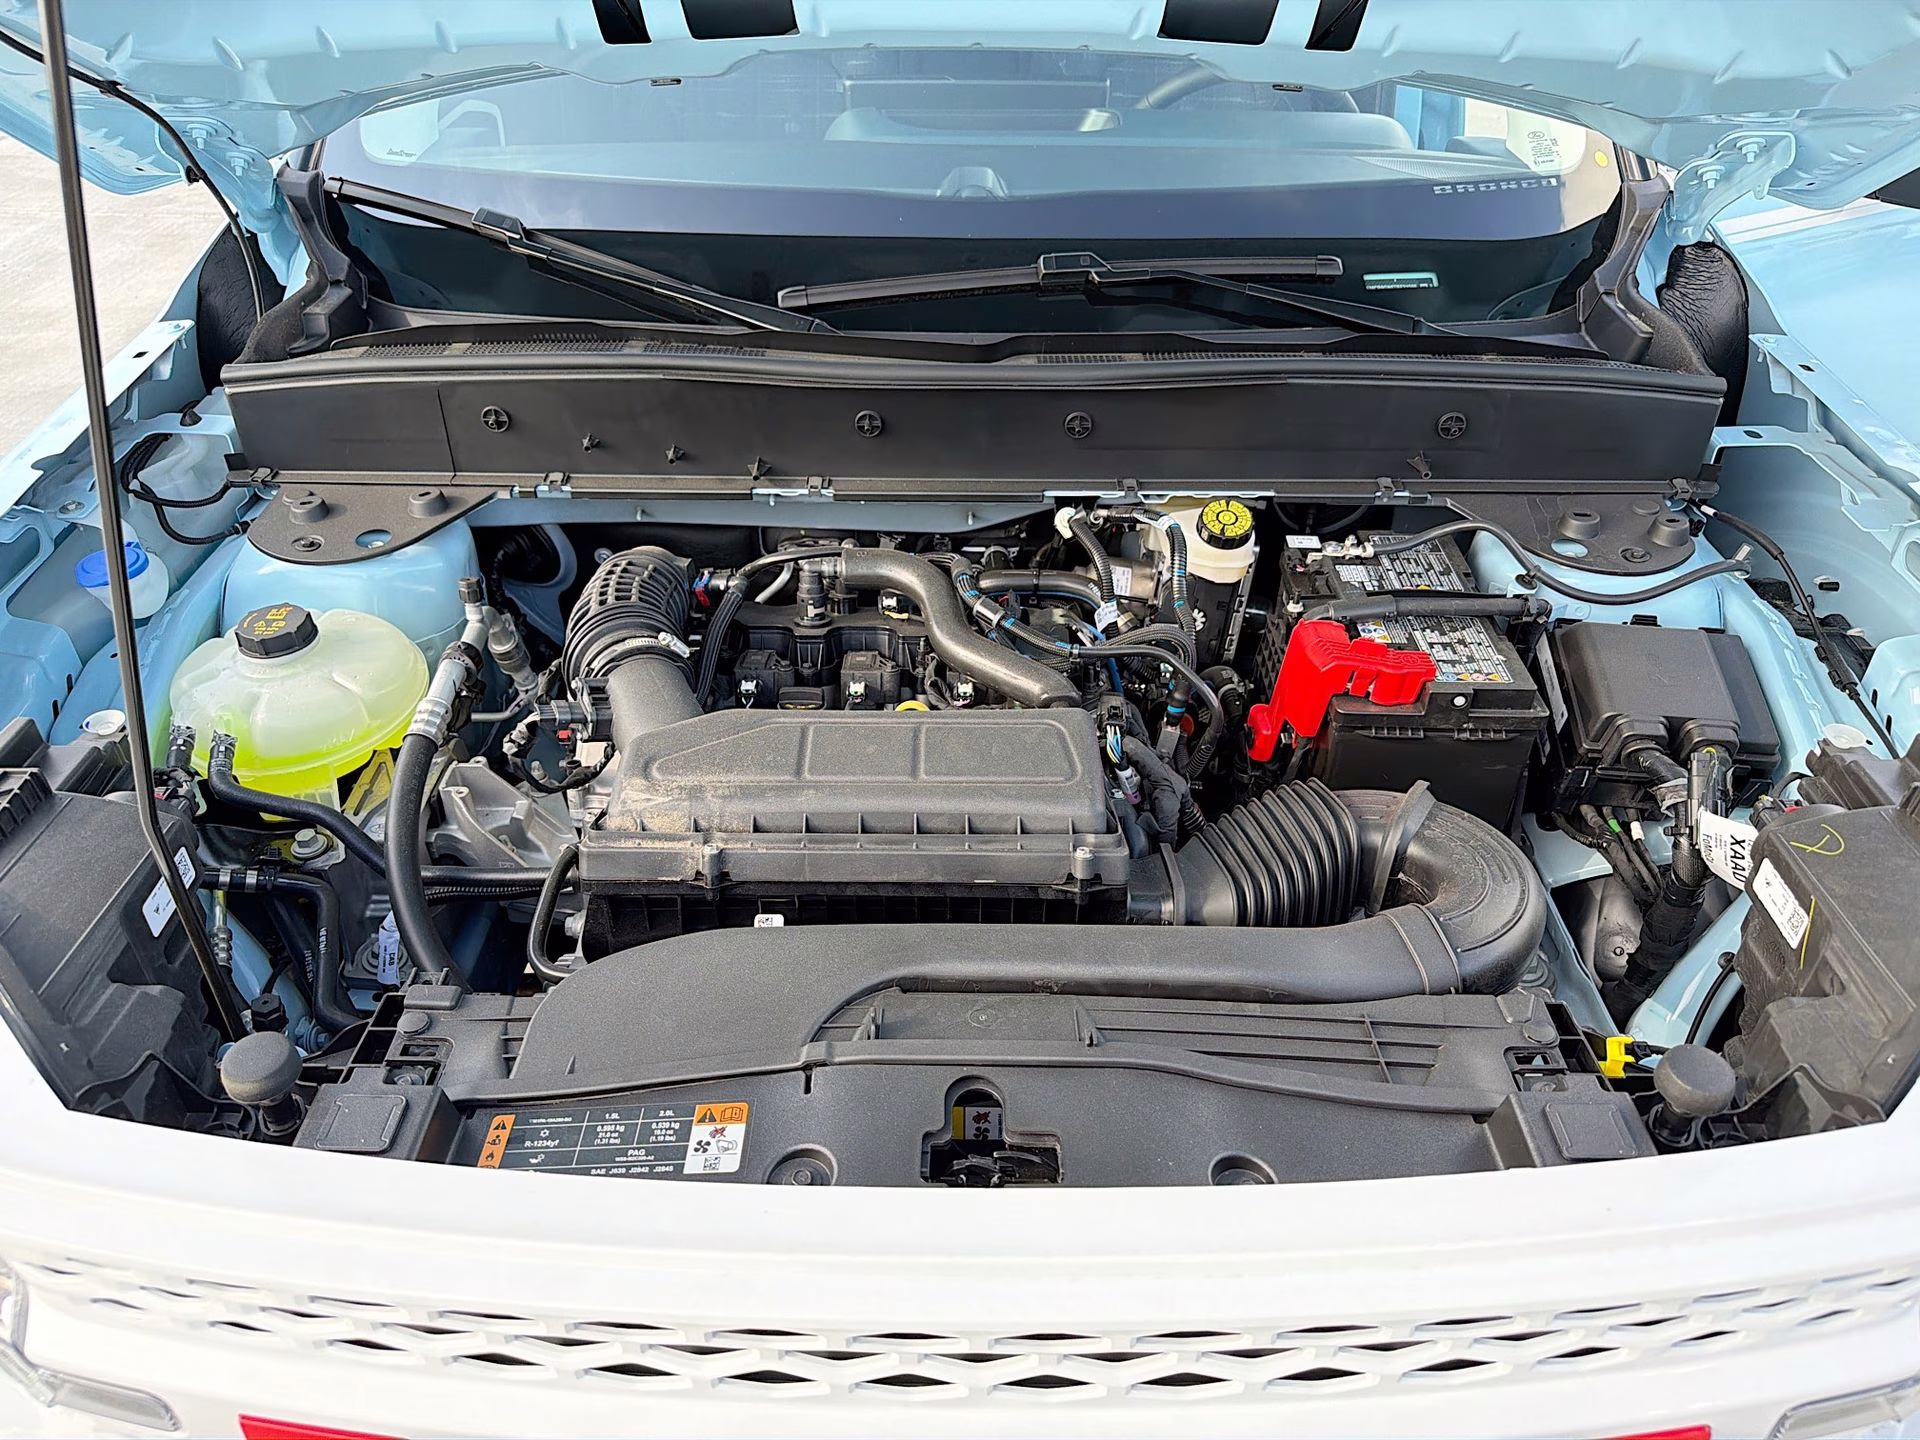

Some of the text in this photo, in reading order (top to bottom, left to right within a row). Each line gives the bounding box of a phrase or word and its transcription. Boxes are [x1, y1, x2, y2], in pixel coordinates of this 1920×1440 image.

[605, 1112, 620, 1120] 1.5L
[616, 1124, 625, 1132] kg
[670, 1122, 680, 1130] kg
[524, 1139, 560, 1148] R-1234yf
